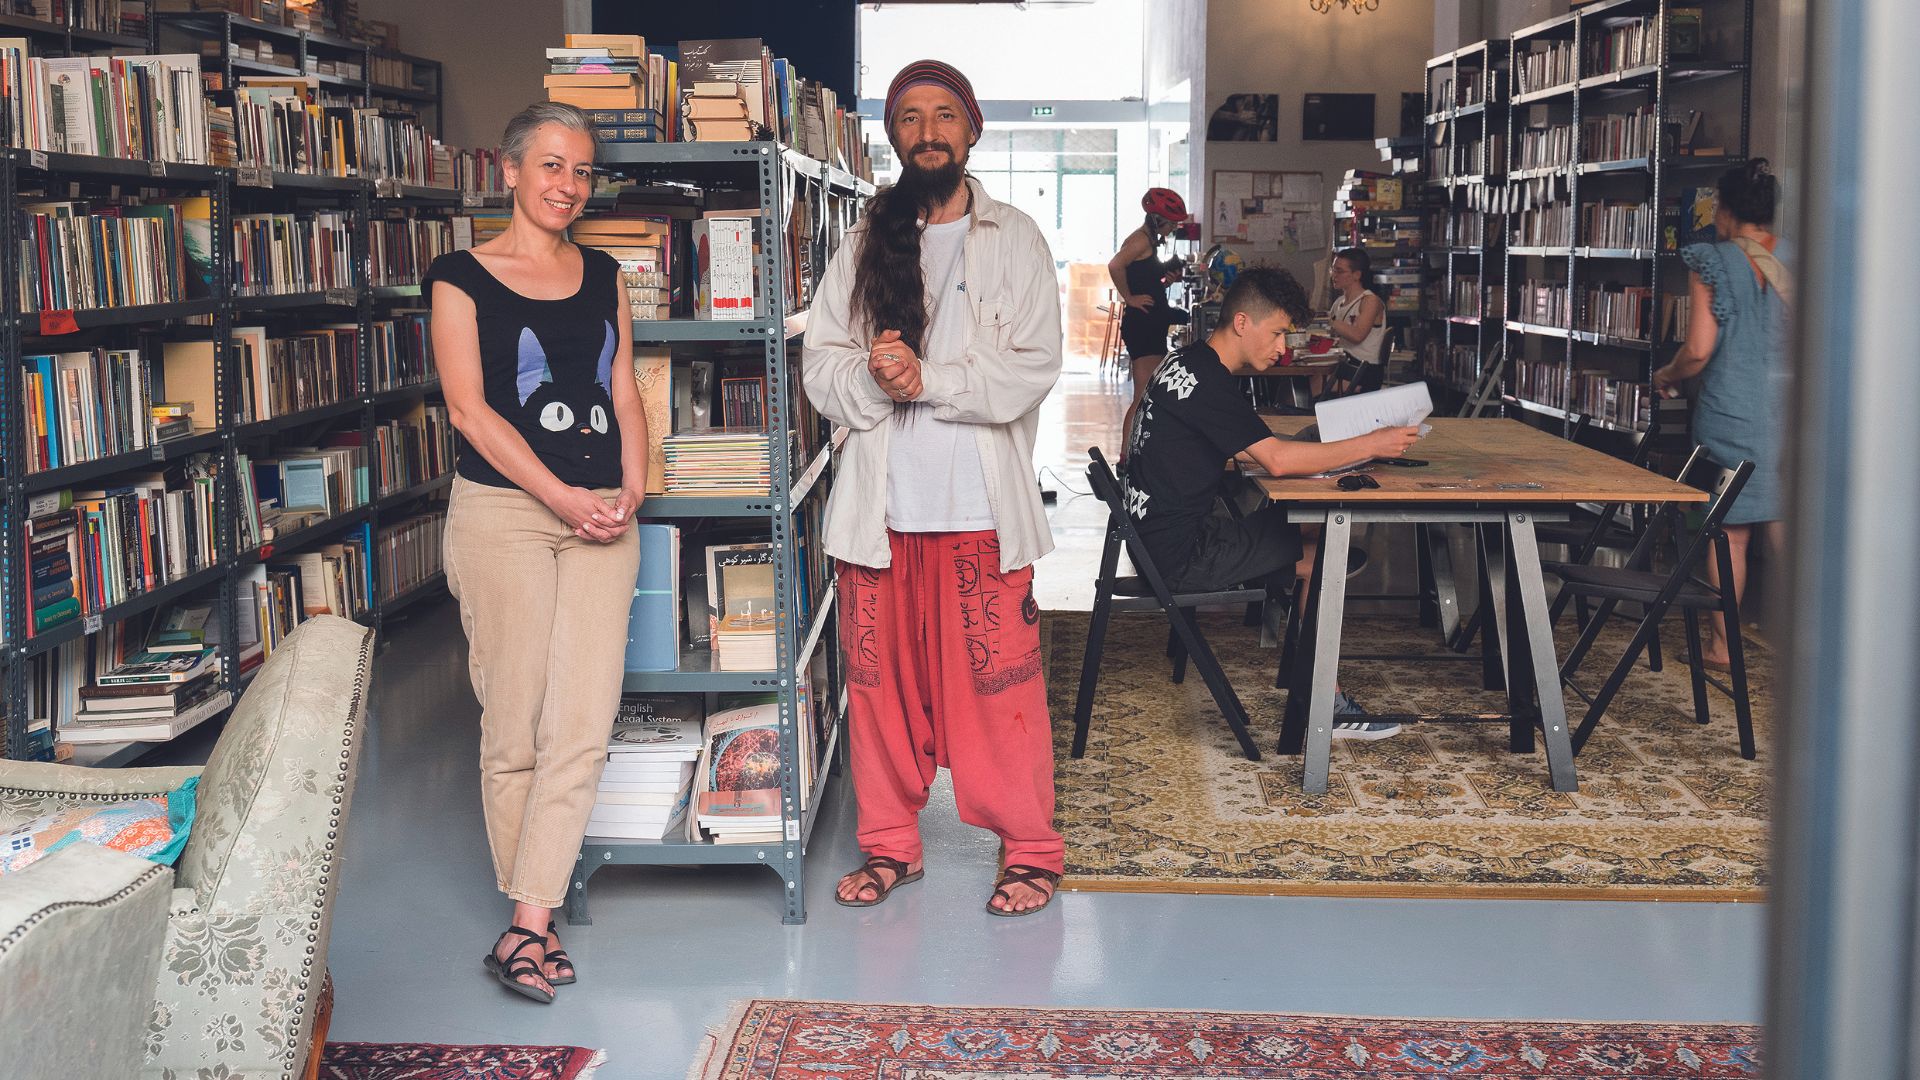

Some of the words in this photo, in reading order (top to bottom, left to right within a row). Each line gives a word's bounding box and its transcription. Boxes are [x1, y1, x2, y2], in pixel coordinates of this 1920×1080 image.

[618, 702, 653, 715] English
[617, 714, 644, 723] Legal
[647, 714, 682, 723] System
